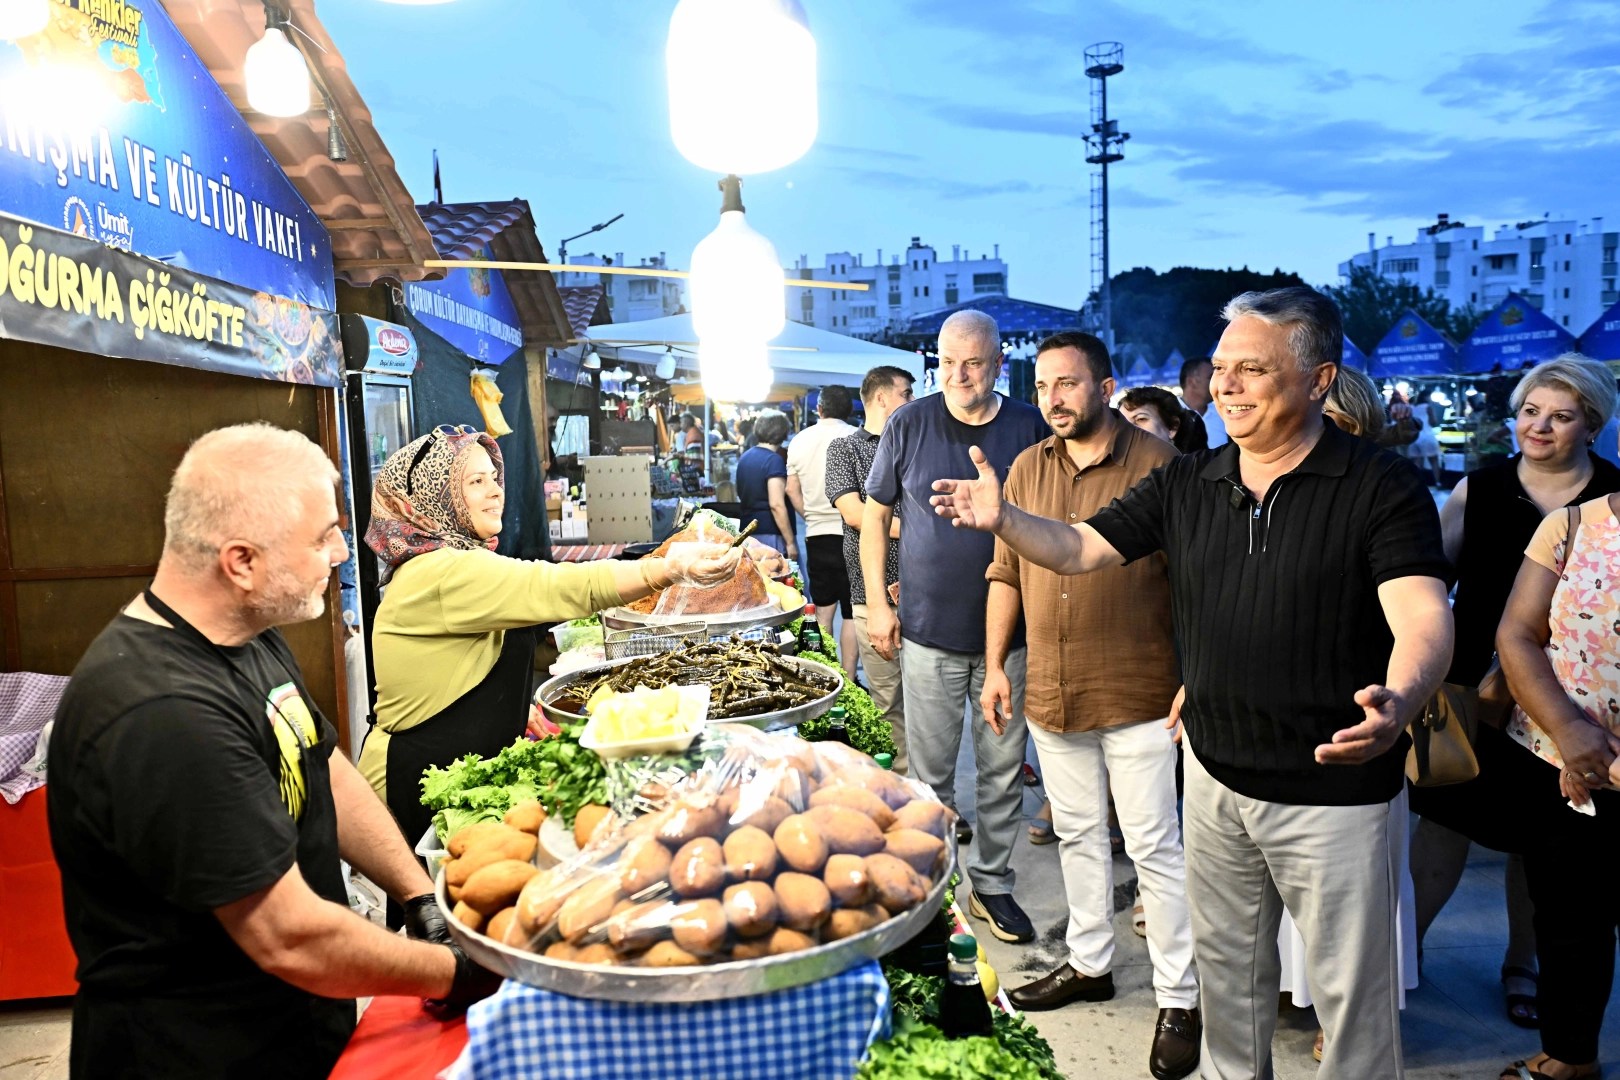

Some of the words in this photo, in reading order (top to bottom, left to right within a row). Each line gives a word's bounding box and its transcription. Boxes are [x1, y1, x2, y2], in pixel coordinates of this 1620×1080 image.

[0, 100, 119, 191] NIŞMA
[124, 137, 160, 207] VE
[166, 154, 250, 242] KÜLTÜR
[252, 200, 303, 262] VAKFI
[97, 201, 131, 236] Ümit
[129, 268, 246, 348] ÇİĞKÖFTE
[409, 284, 434, 316] ÇORUM
[433, 289, 456, 323] KÜLTÜR
